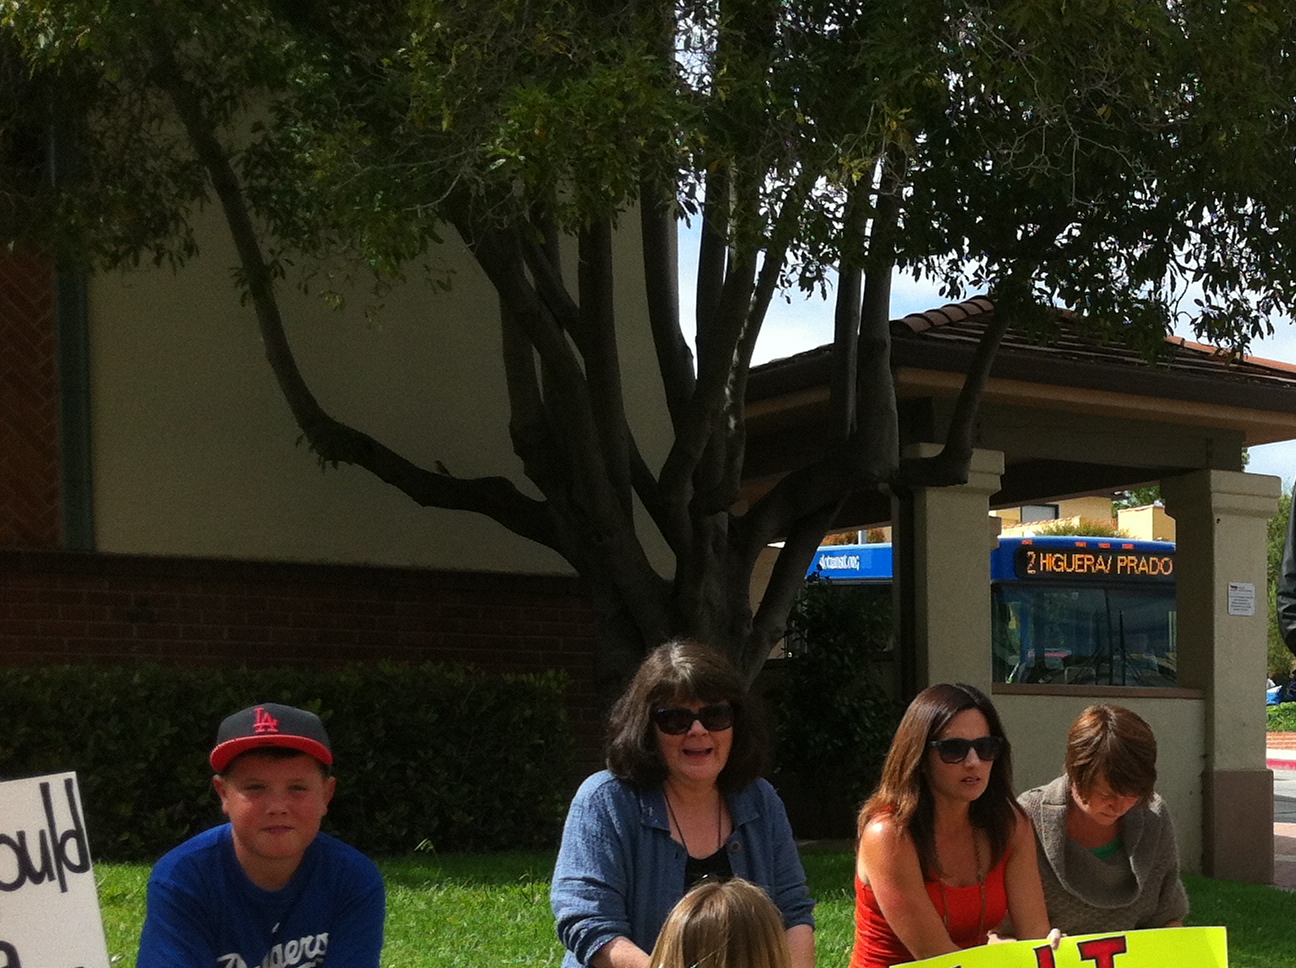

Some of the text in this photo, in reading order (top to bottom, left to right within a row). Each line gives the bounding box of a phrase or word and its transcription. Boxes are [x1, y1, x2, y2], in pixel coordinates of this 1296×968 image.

[1026, 551, 1174, 576] 2 HIGUERA/ PRADO
[253, 707, 279, 734] LA
